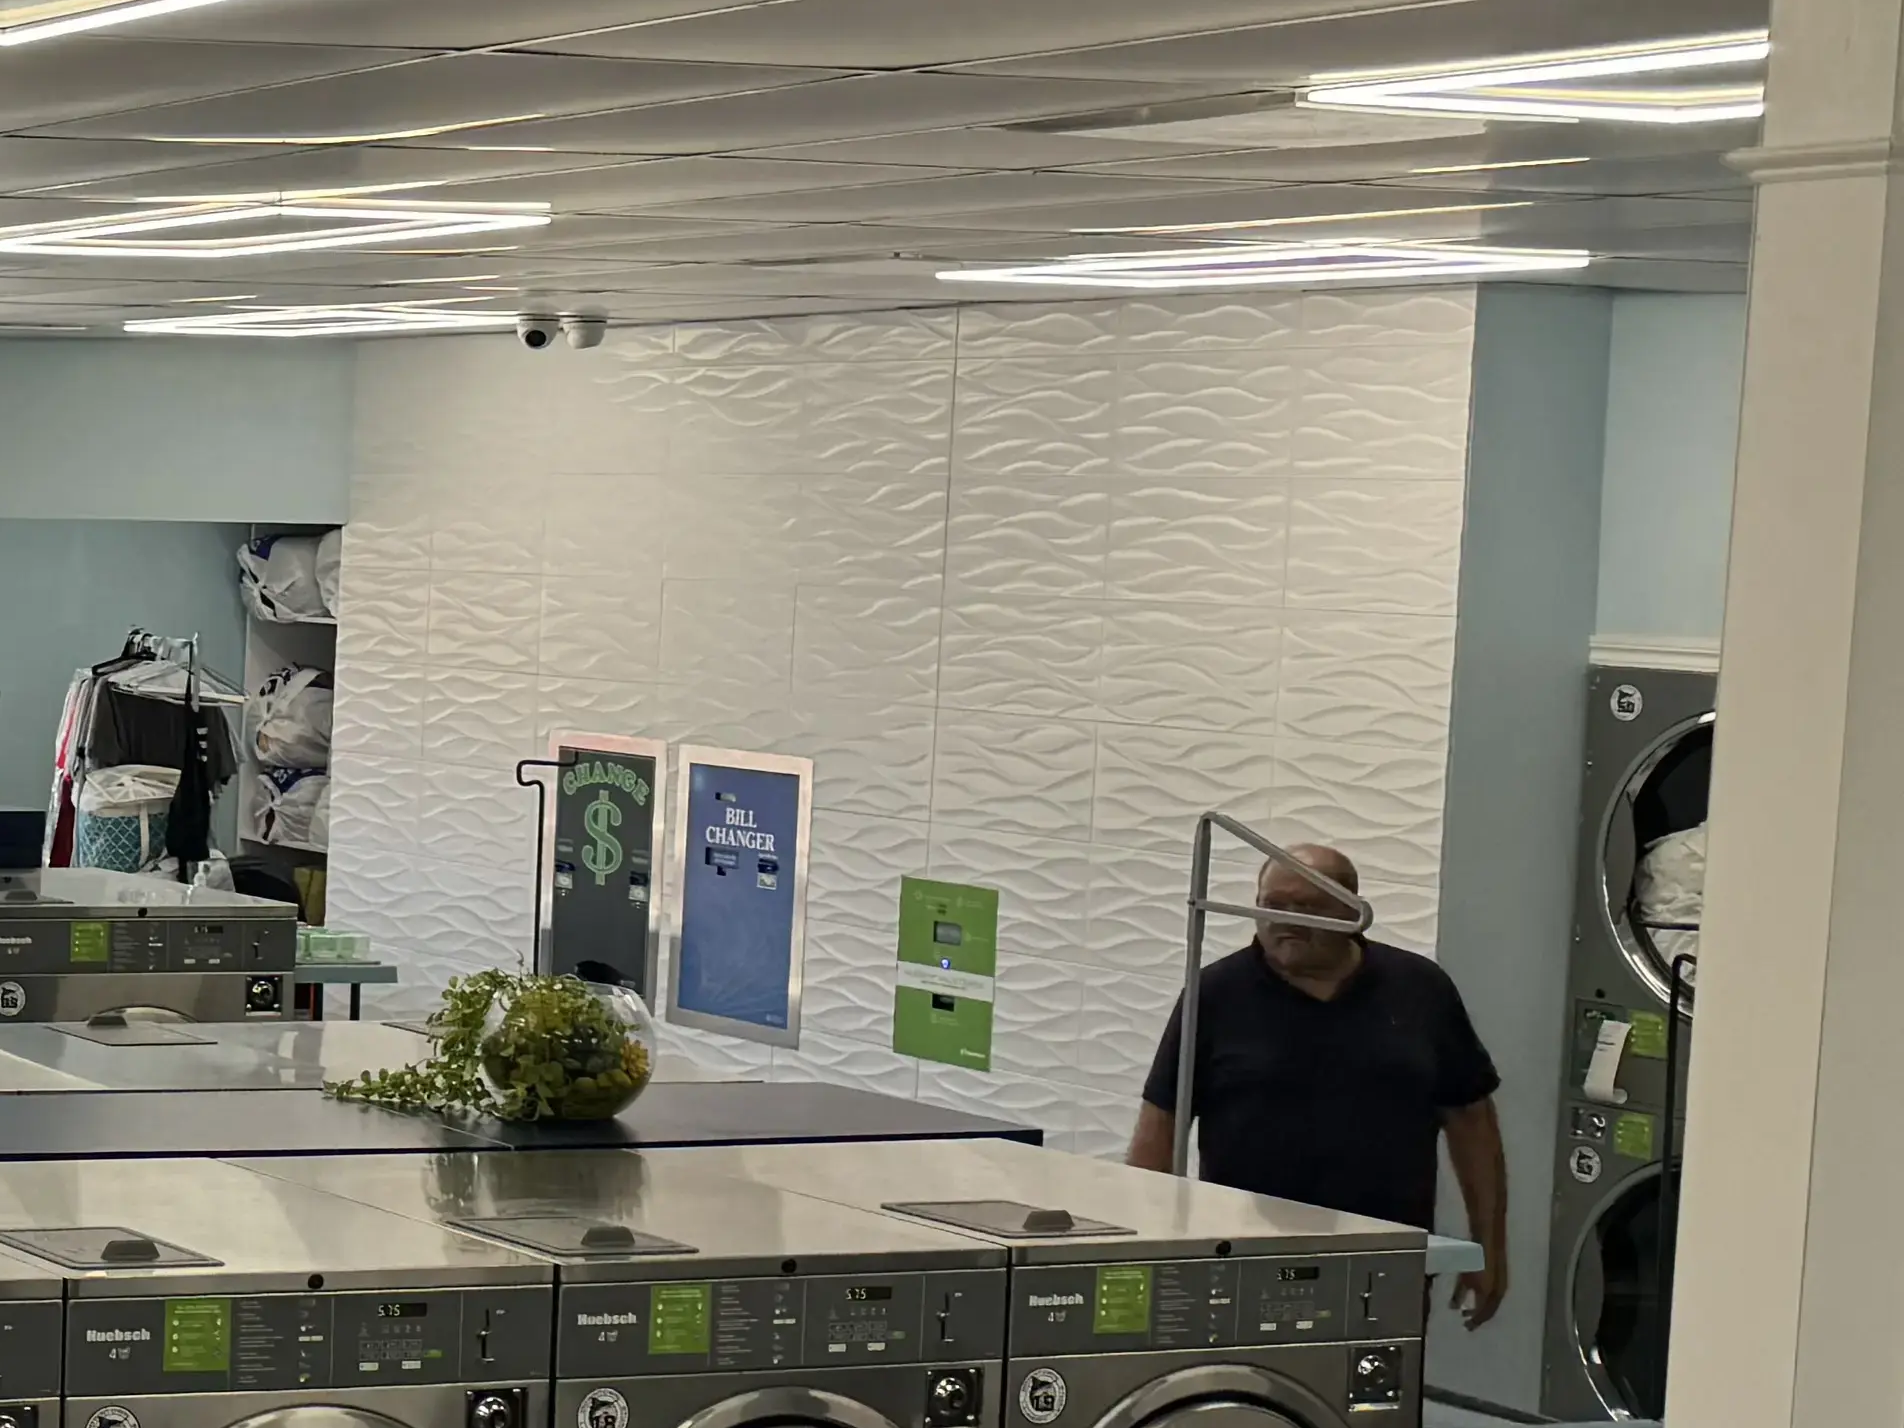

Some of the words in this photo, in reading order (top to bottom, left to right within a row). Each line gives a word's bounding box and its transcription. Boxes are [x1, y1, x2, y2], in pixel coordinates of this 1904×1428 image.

[562, 760, 650, 806] CHANGE
[725, 807, 758, 829] BILL
[705, 826, 775, 852] CHANGER
[577, 1311, 638, 1327] Huebsch
[86, 1327, 150, 1343] Huebsch
